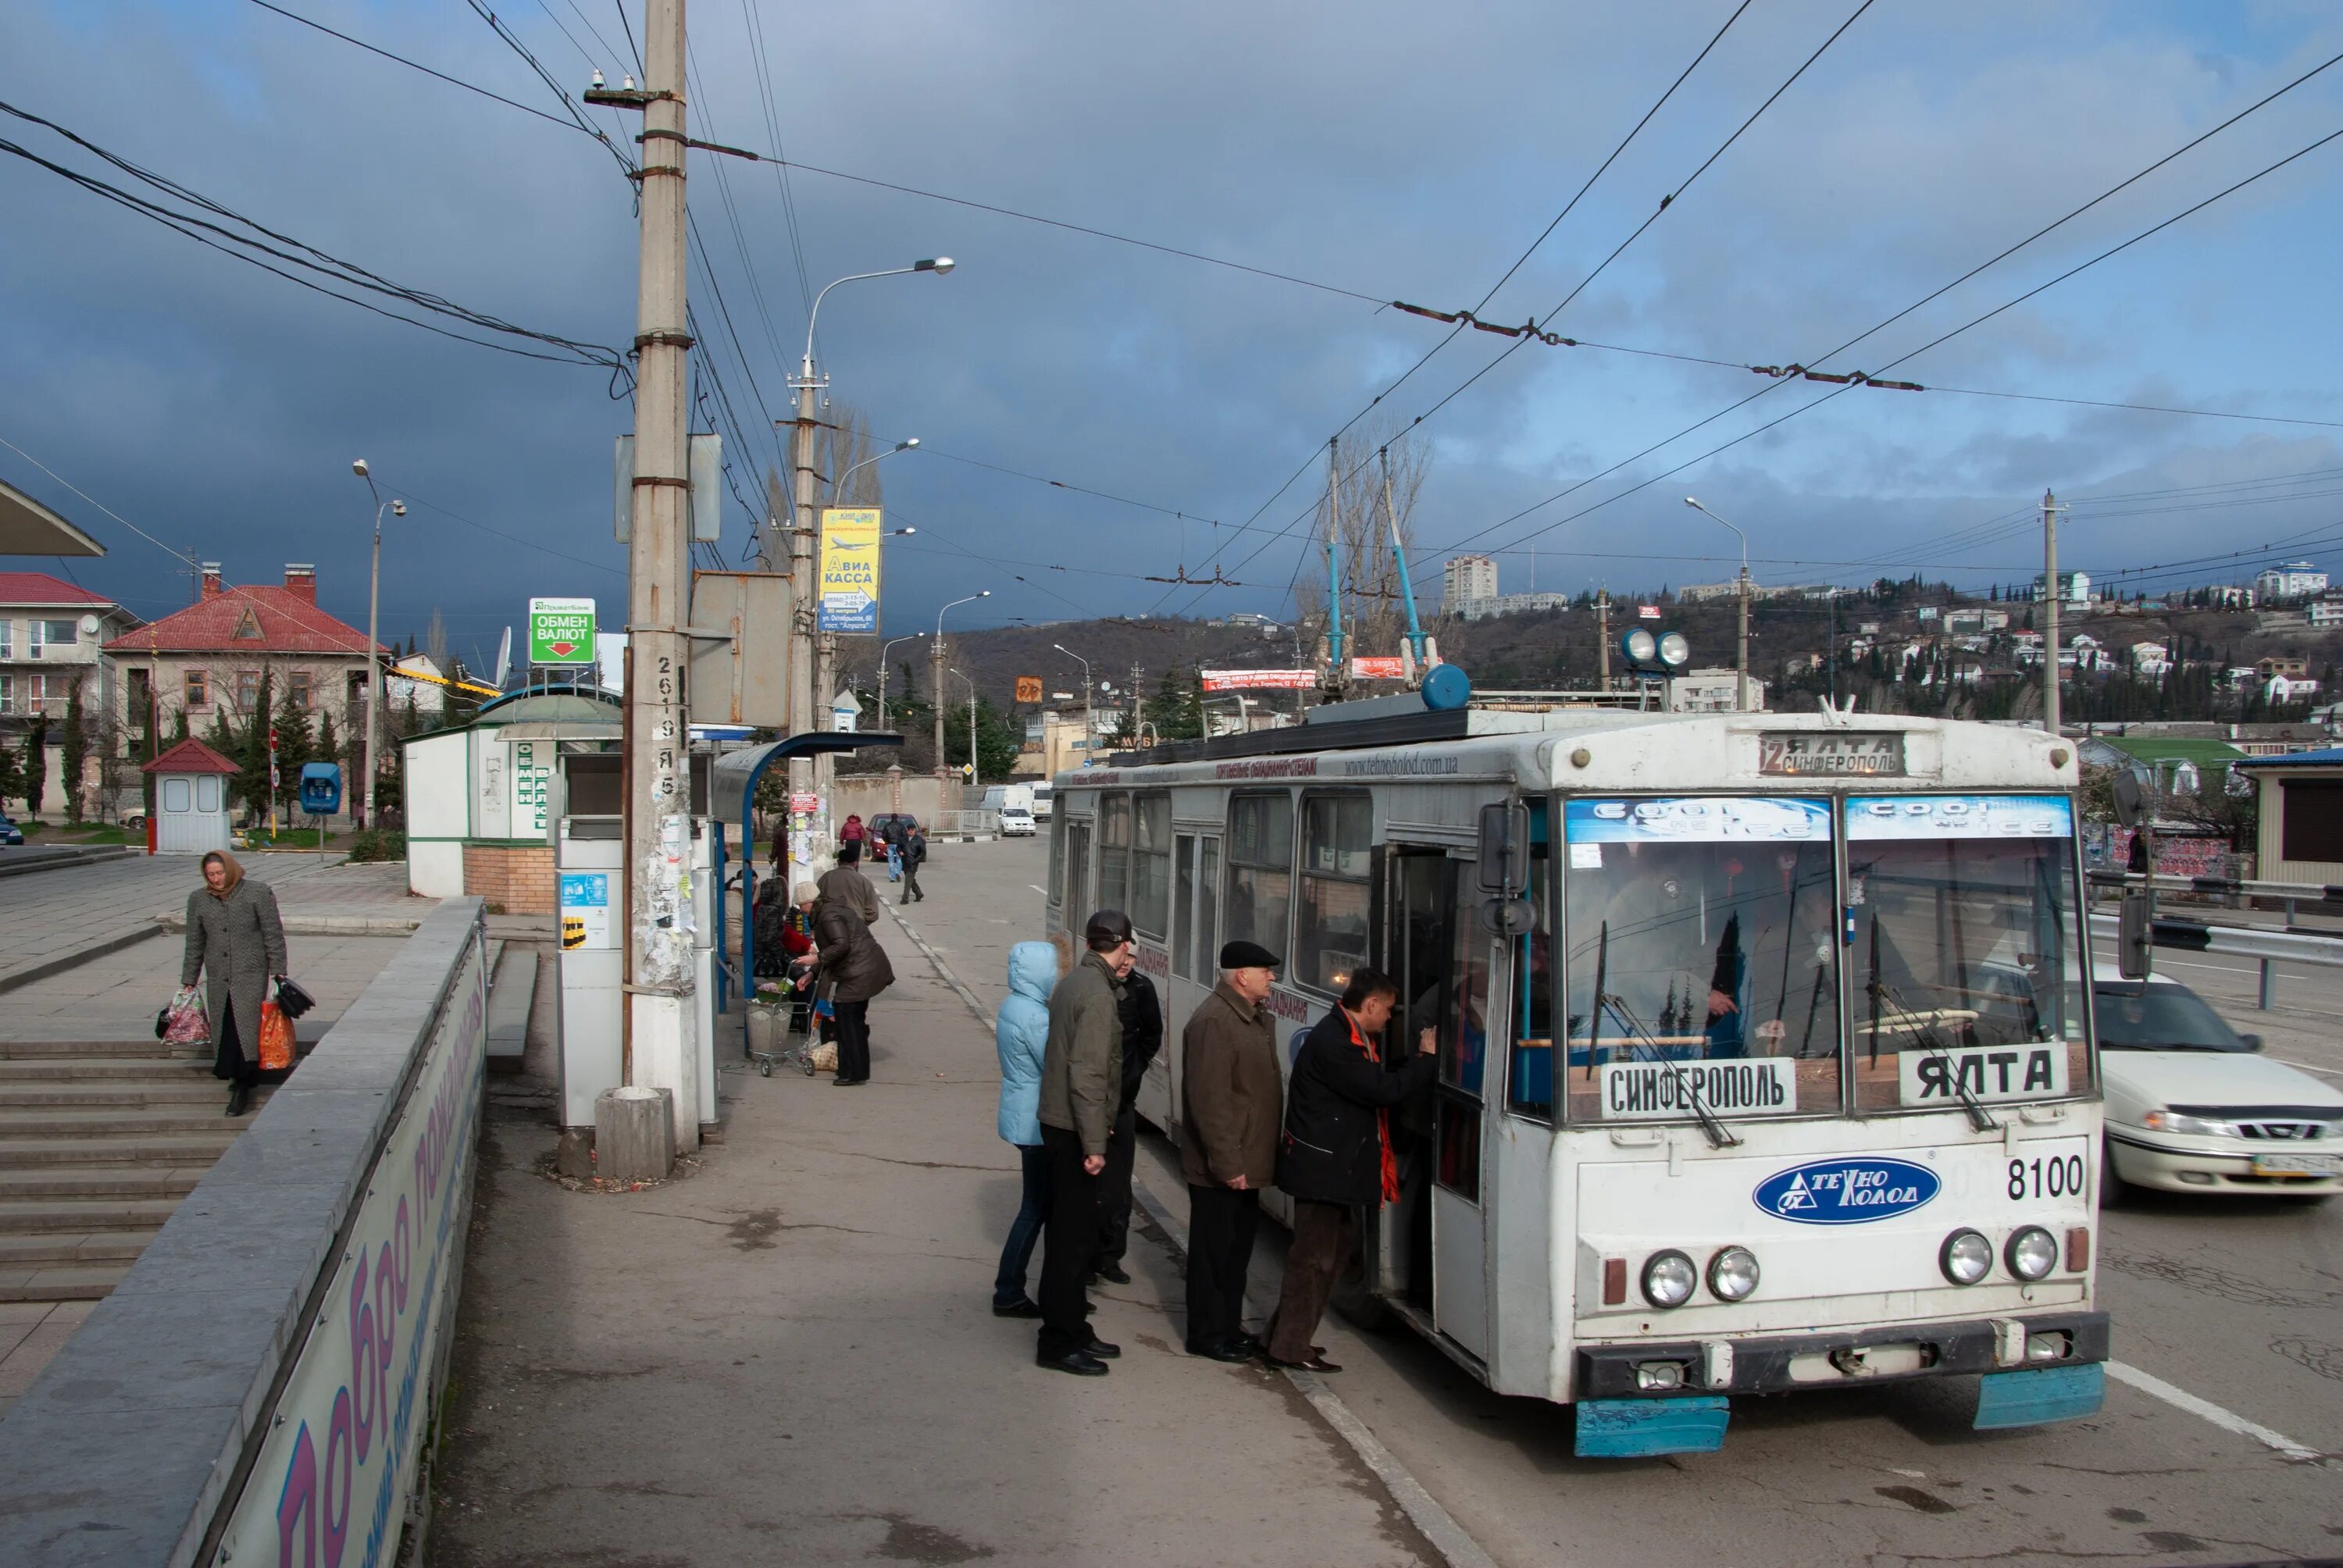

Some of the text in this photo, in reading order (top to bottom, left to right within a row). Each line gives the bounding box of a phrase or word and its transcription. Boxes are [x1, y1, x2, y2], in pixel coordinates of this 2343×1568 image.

[825, 572, 872, 583] КАССА
[537, 615, 588, 628] ОБМЕН
[537, 629, 587, 640] ВАЛЮТ
[1787, 739, 1895, 754] ЯЛТА
[1345, 752, 1458, 775] www.tehnoholod.com.ua
[1782, 755, 1896, 771] СИМФЕРОПОЛЬ
[519, 743, 533, 804] ОБМЕН
[1917, 1049, 2053, 1099] ЯЛТА
[1610, 1064, 1785, 1112] СИМФЕРОПОЛЬ
[2008, 1154, 2083, 1201] 8100
